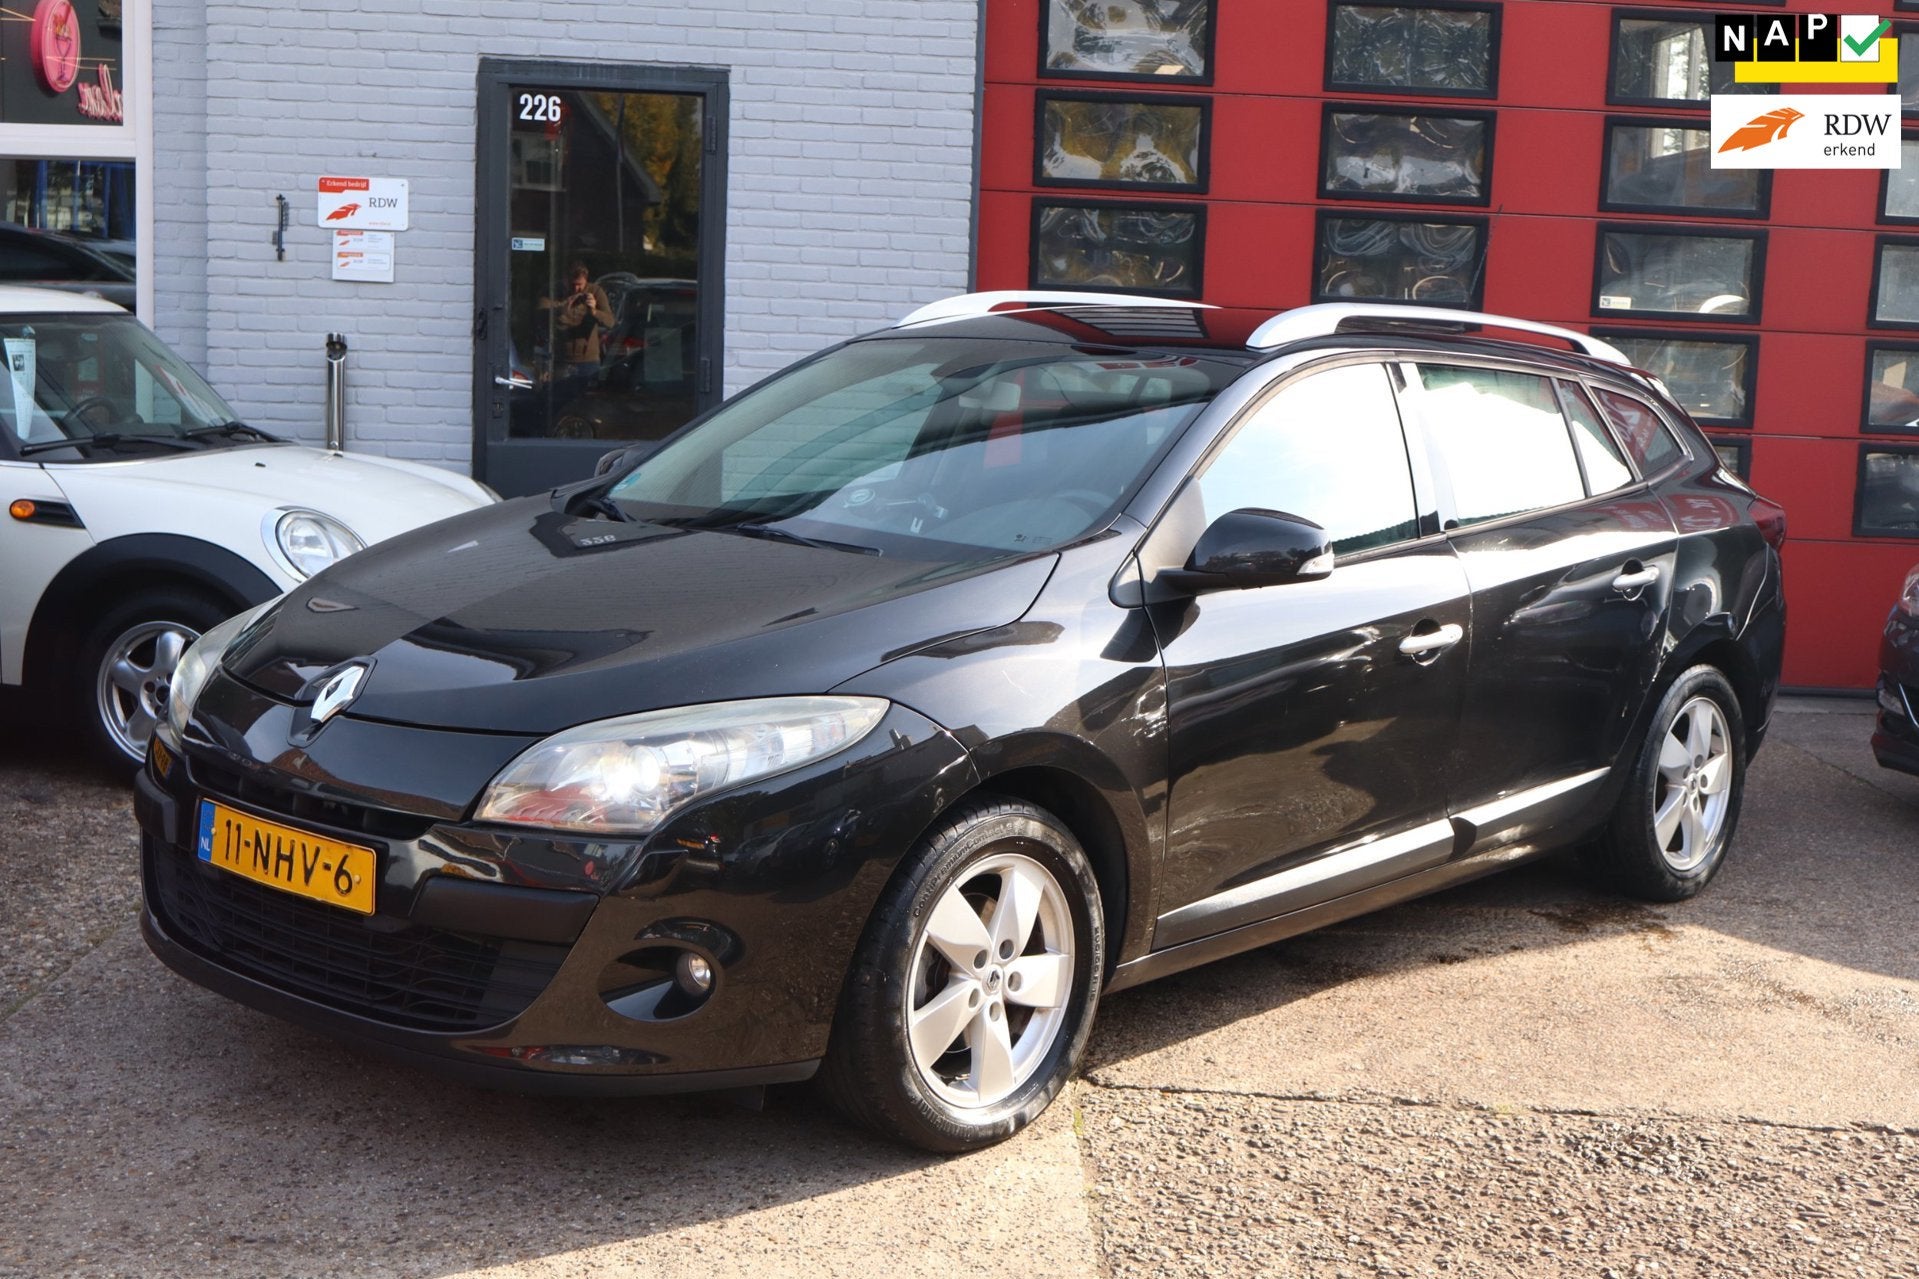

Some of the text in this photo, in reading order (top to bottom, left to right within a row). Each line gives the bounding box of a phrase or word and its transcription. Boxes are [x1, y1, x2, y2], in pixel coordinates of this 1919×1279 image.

[519, 93, 562, 122] 226
[347, 180, 367, 189] bedrijf
[368, 197, 398, 208] RDW
[200, 837, 210, 852] NL
[225, 818, 354, 897] 11-NHV-6
